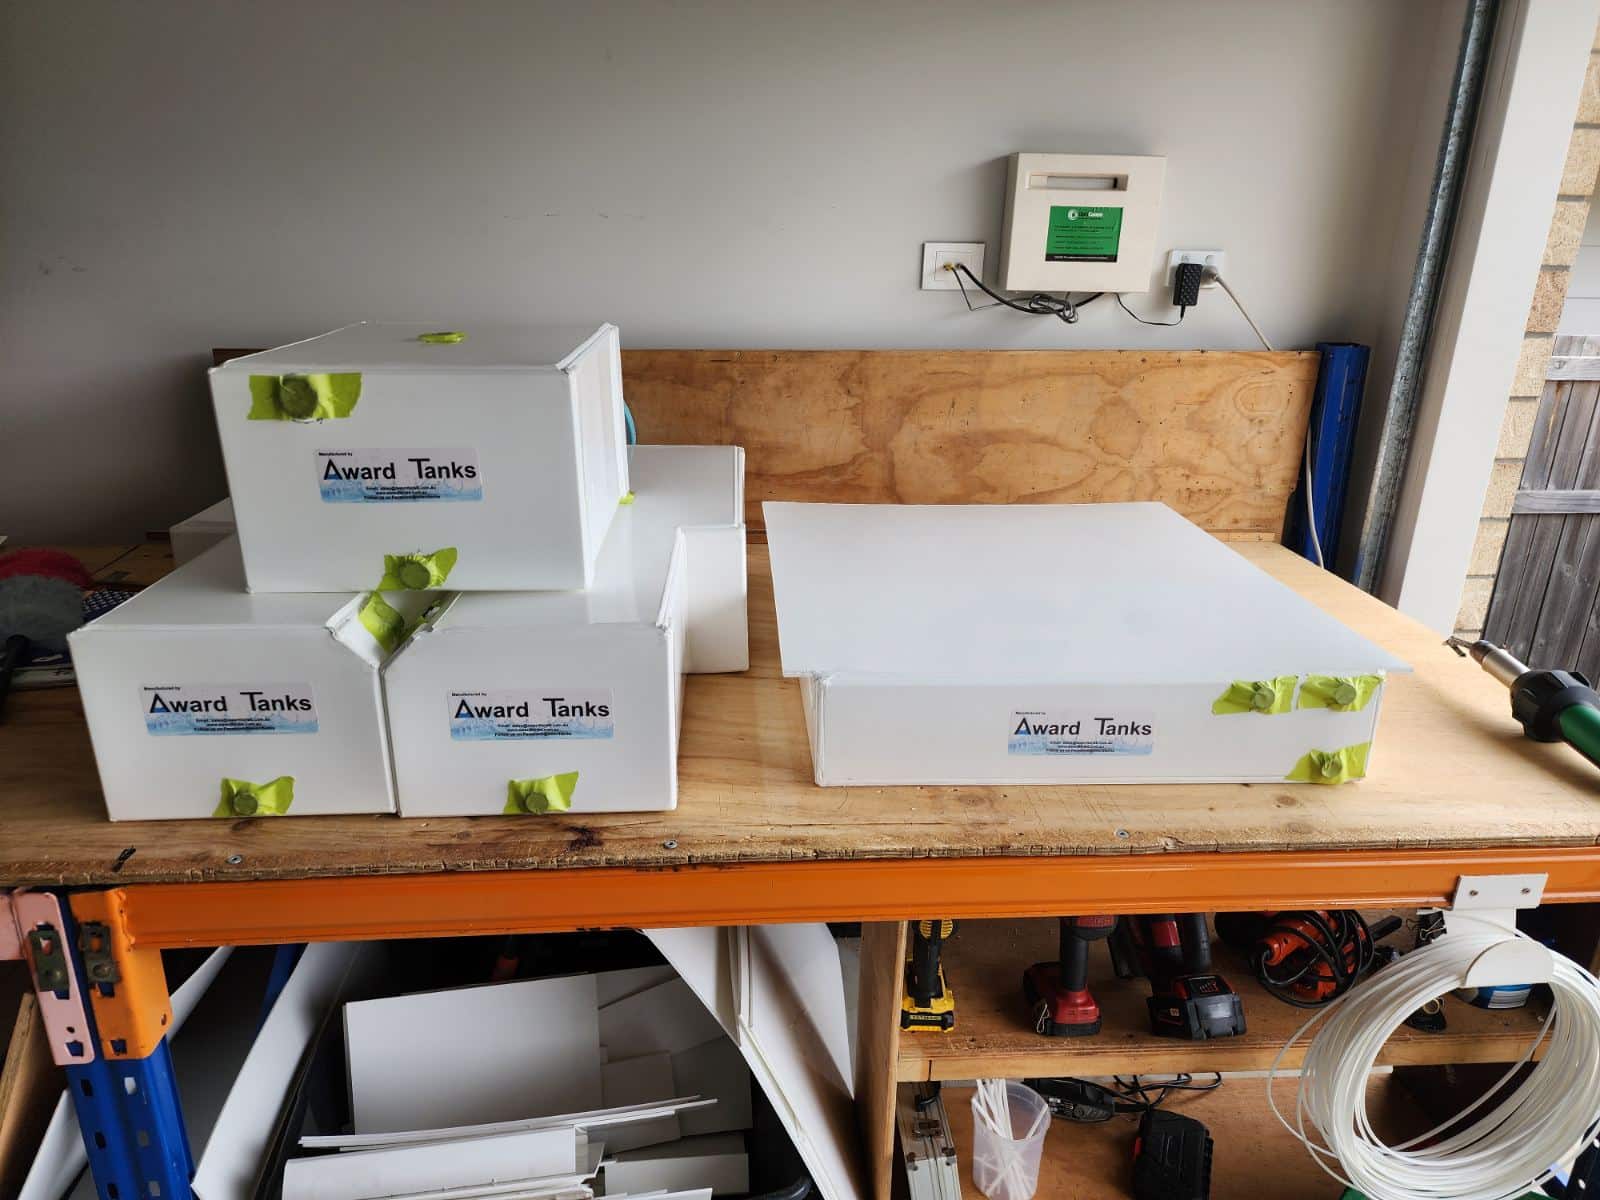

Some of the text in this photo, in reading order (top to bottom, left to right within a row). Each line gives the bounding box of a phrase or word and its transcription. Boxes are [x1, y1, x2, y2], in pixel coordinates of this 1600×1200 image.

[323, 458, 477, 481] Award Tanks
[149, 691, 312, 713] Award Tanks
[454, 697, 610, 718] Award Tanks
[1014, 717, 1152, 736] Award Tanks
